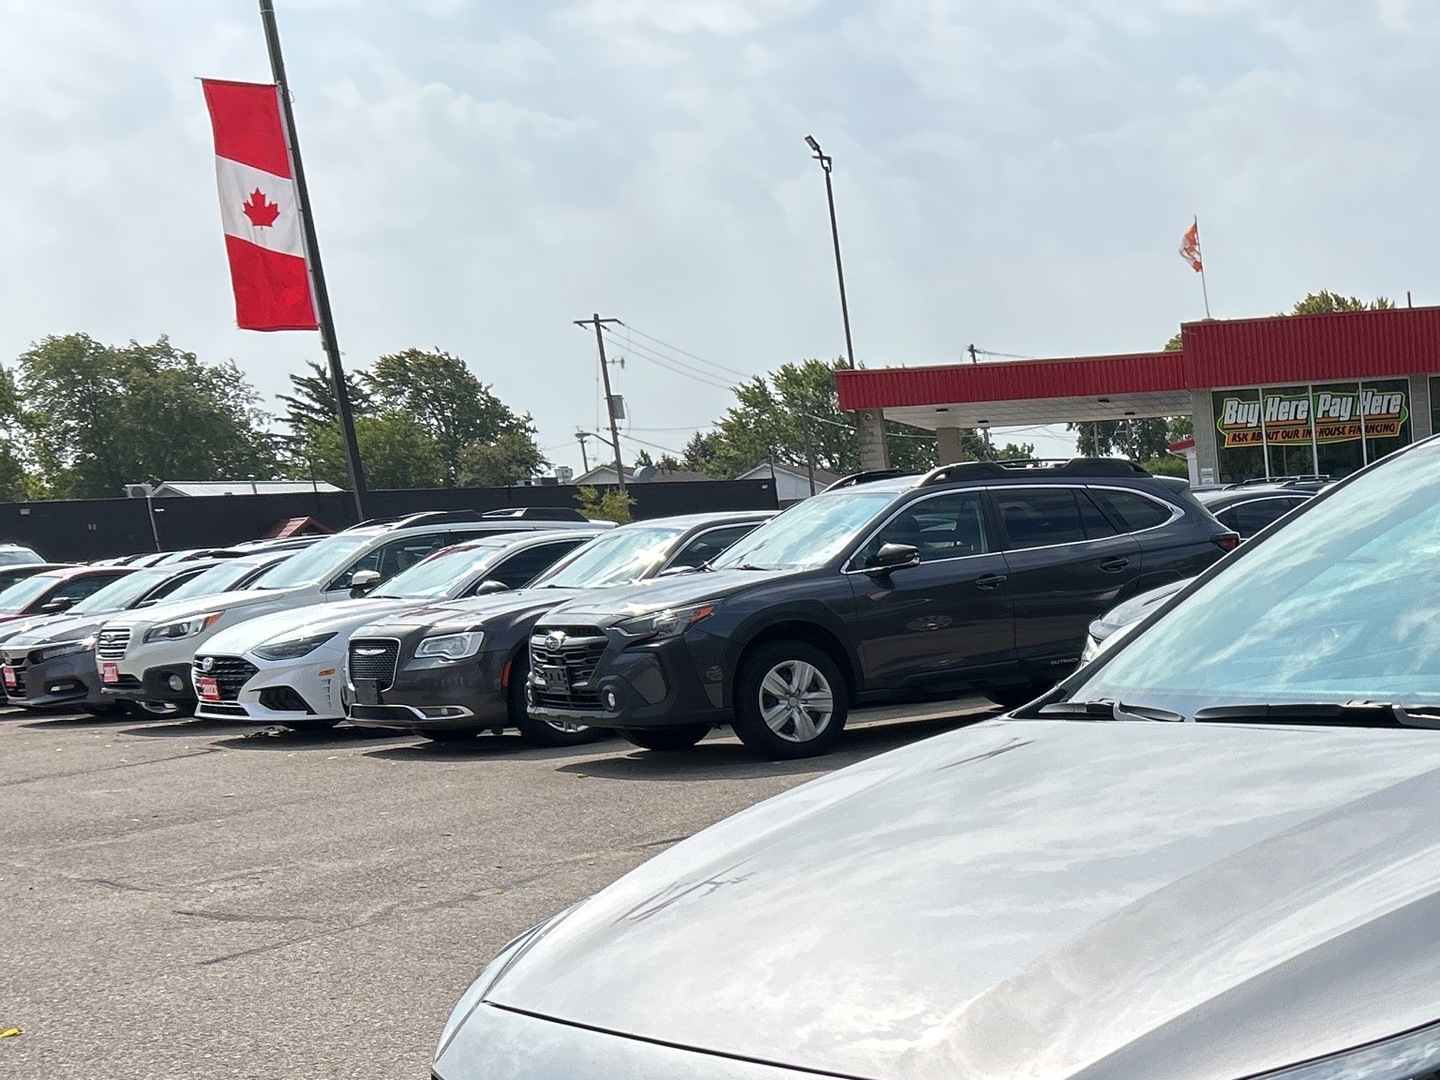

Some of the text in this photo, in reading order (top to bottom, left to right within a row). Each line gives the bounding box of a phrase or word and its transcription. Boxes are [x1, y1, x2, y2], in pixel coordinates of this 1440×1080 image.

[1224, 391, 1401, 427] Buy Here Pay Here
[1231, 432, 1249, 443] ASK
[1281, 428, 1300, 440] OUR
